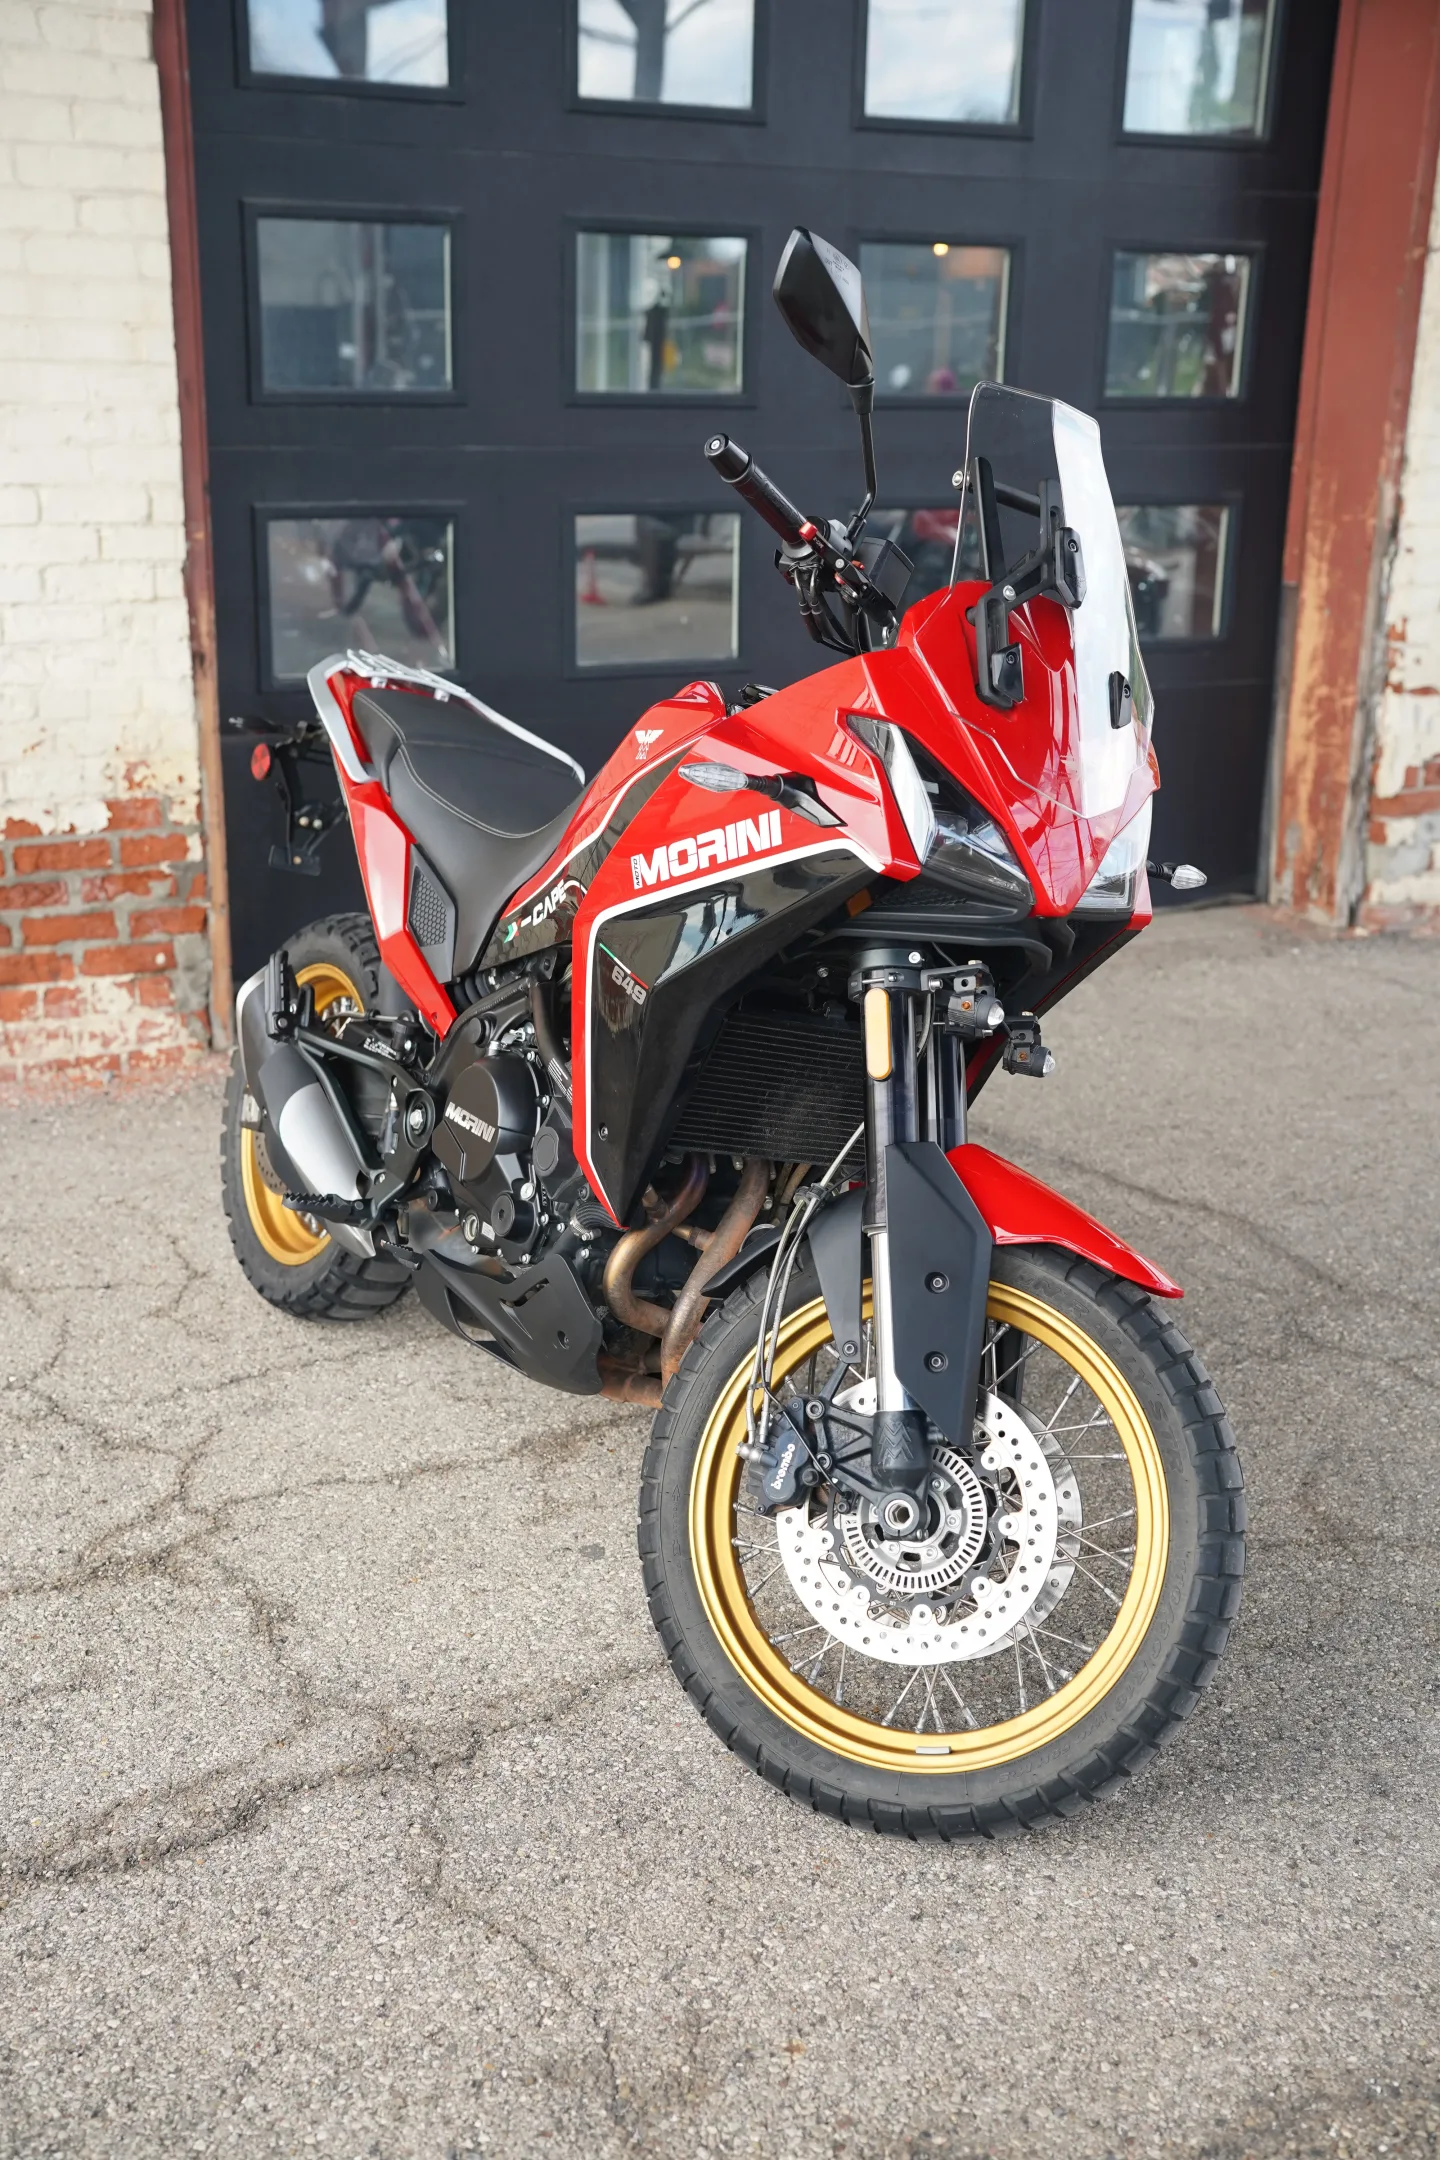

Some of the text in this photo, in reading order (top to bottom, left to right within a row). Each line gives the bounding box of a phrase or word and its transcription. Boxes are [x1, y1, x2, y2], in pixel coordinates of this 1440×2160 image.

[640, 809, 783, 886] MORINI
[504, 879, 567, 943] X-CAPE
[612, 965, 647, 1005] 649
[445, 1101, 496, 1143] MORINI
[771, 1443, 796, 1490] brembo
[720, 1680, 840, 1773] PIRELLI
